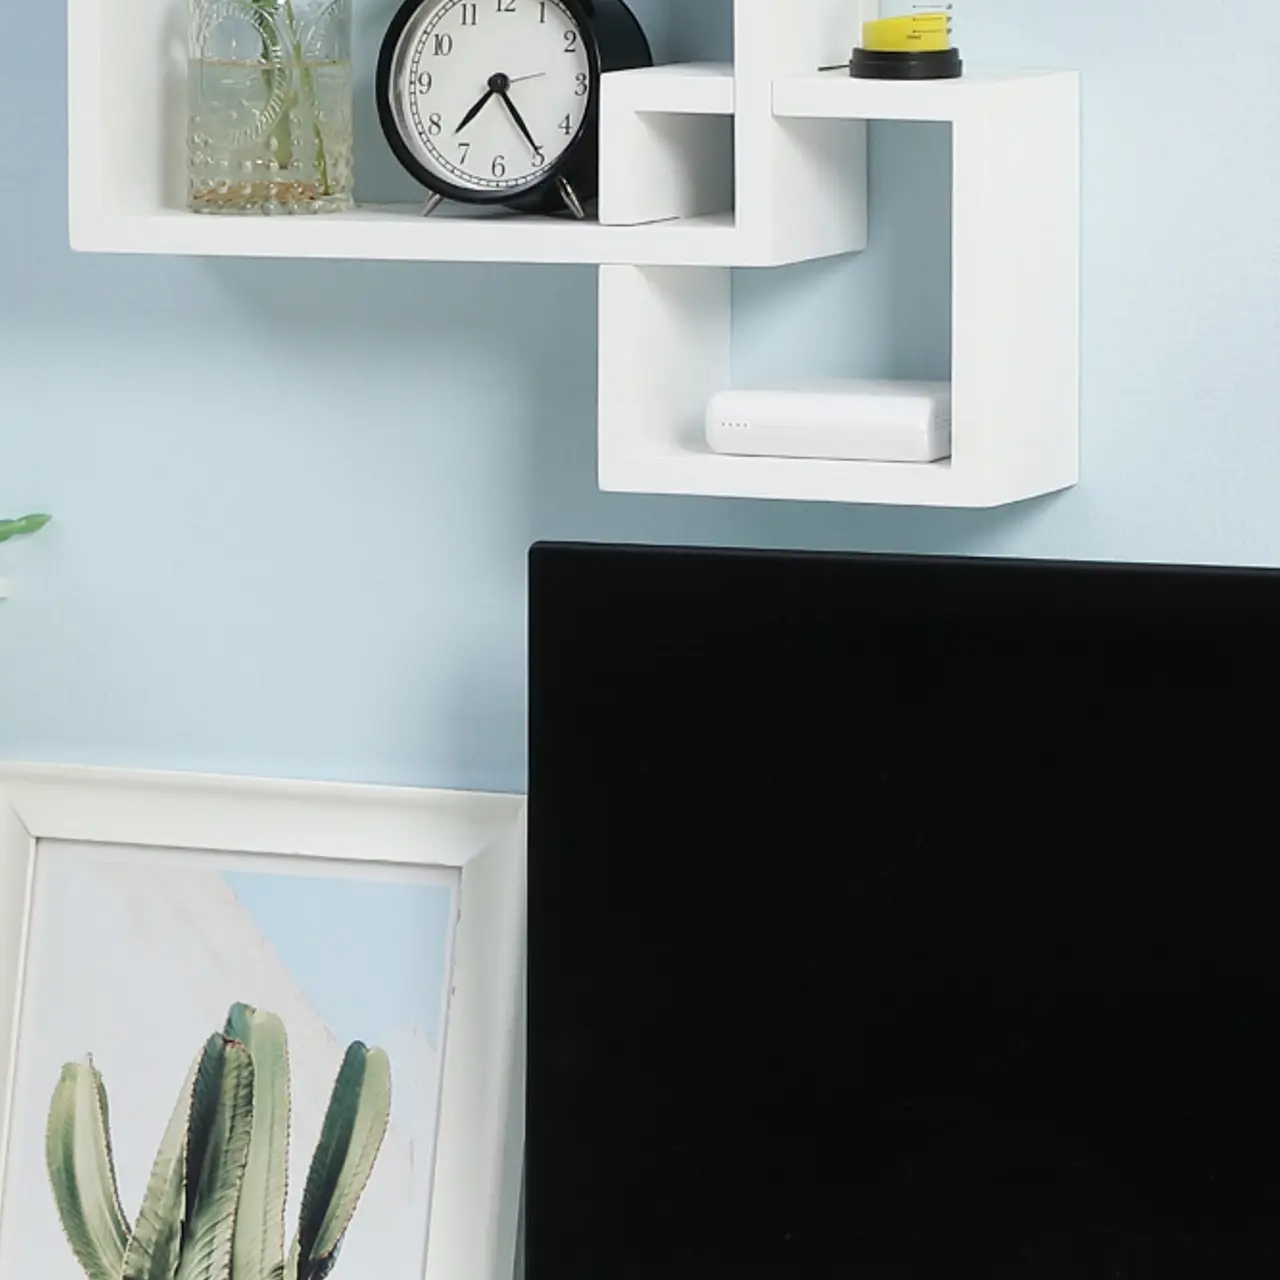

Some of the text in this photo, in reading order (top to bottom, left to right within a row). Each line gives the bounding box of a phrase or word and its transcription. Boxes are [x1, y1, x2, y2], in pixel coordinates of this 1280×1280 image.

[461, 3, 477, 26] 11
[539, 1, 545, 24] 1
[433, 33, 453, 56] 10
[563, 30, 577, 53] 2
[418, 71, 432, 95] 9
[575, 72, 587, 96] 3
[428, 113, 441, 136] 8
[558, 113, 572, 136] 4
[457, 143, 470, 164] 7
[491, 154, 505, 178] 6
